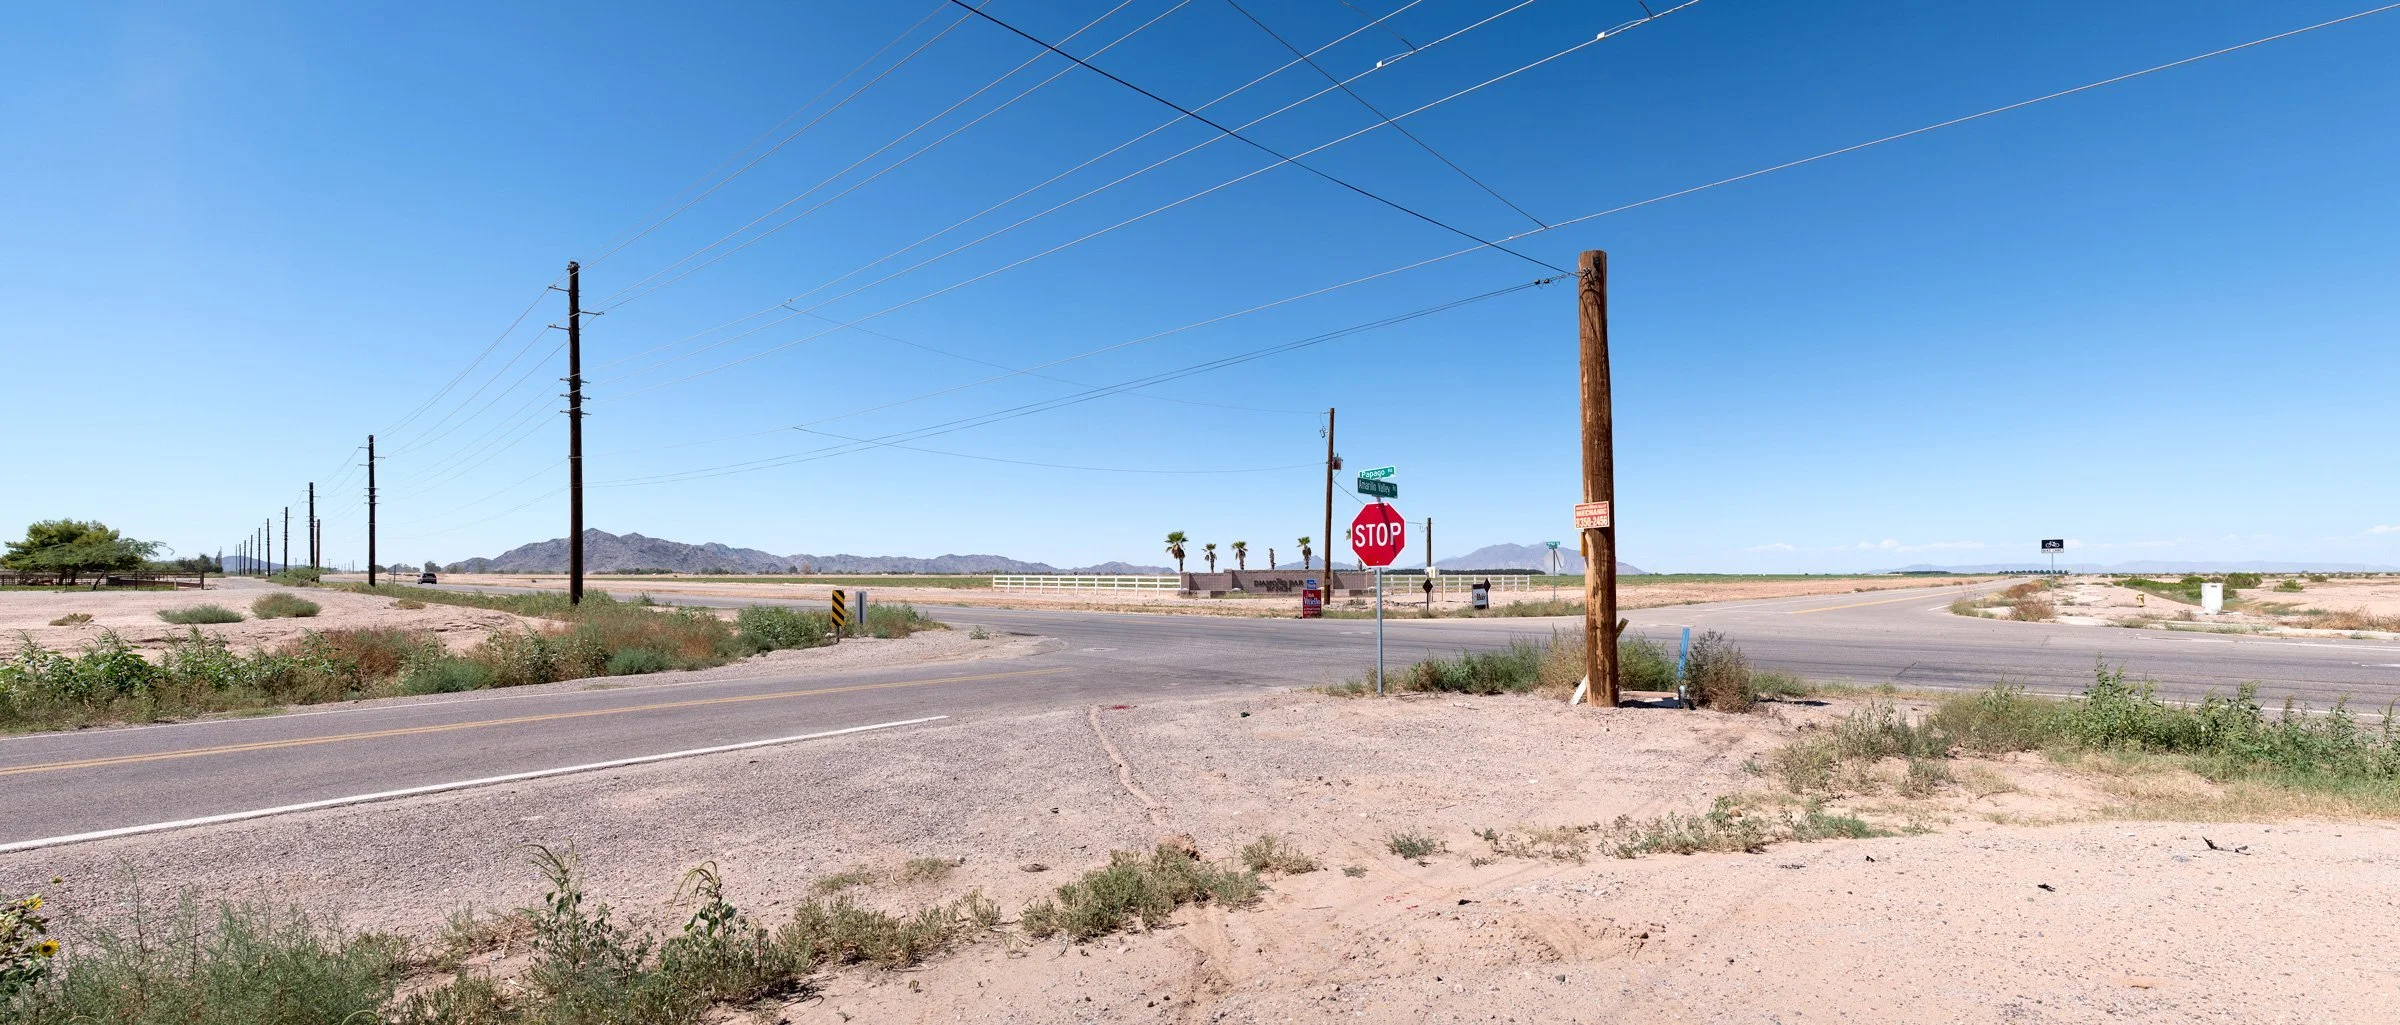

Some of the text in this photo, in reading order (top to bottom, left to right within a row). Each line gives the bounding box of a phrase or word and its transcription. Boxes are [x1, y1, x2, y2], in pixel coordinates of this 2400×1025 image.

[1361, 470, 1385, 479] Papago
[1359, 479, 1377, 491] Amarillo
[1378, 483, 1391, 496] Valley
[1355, 522, 1401, 548] STOP
